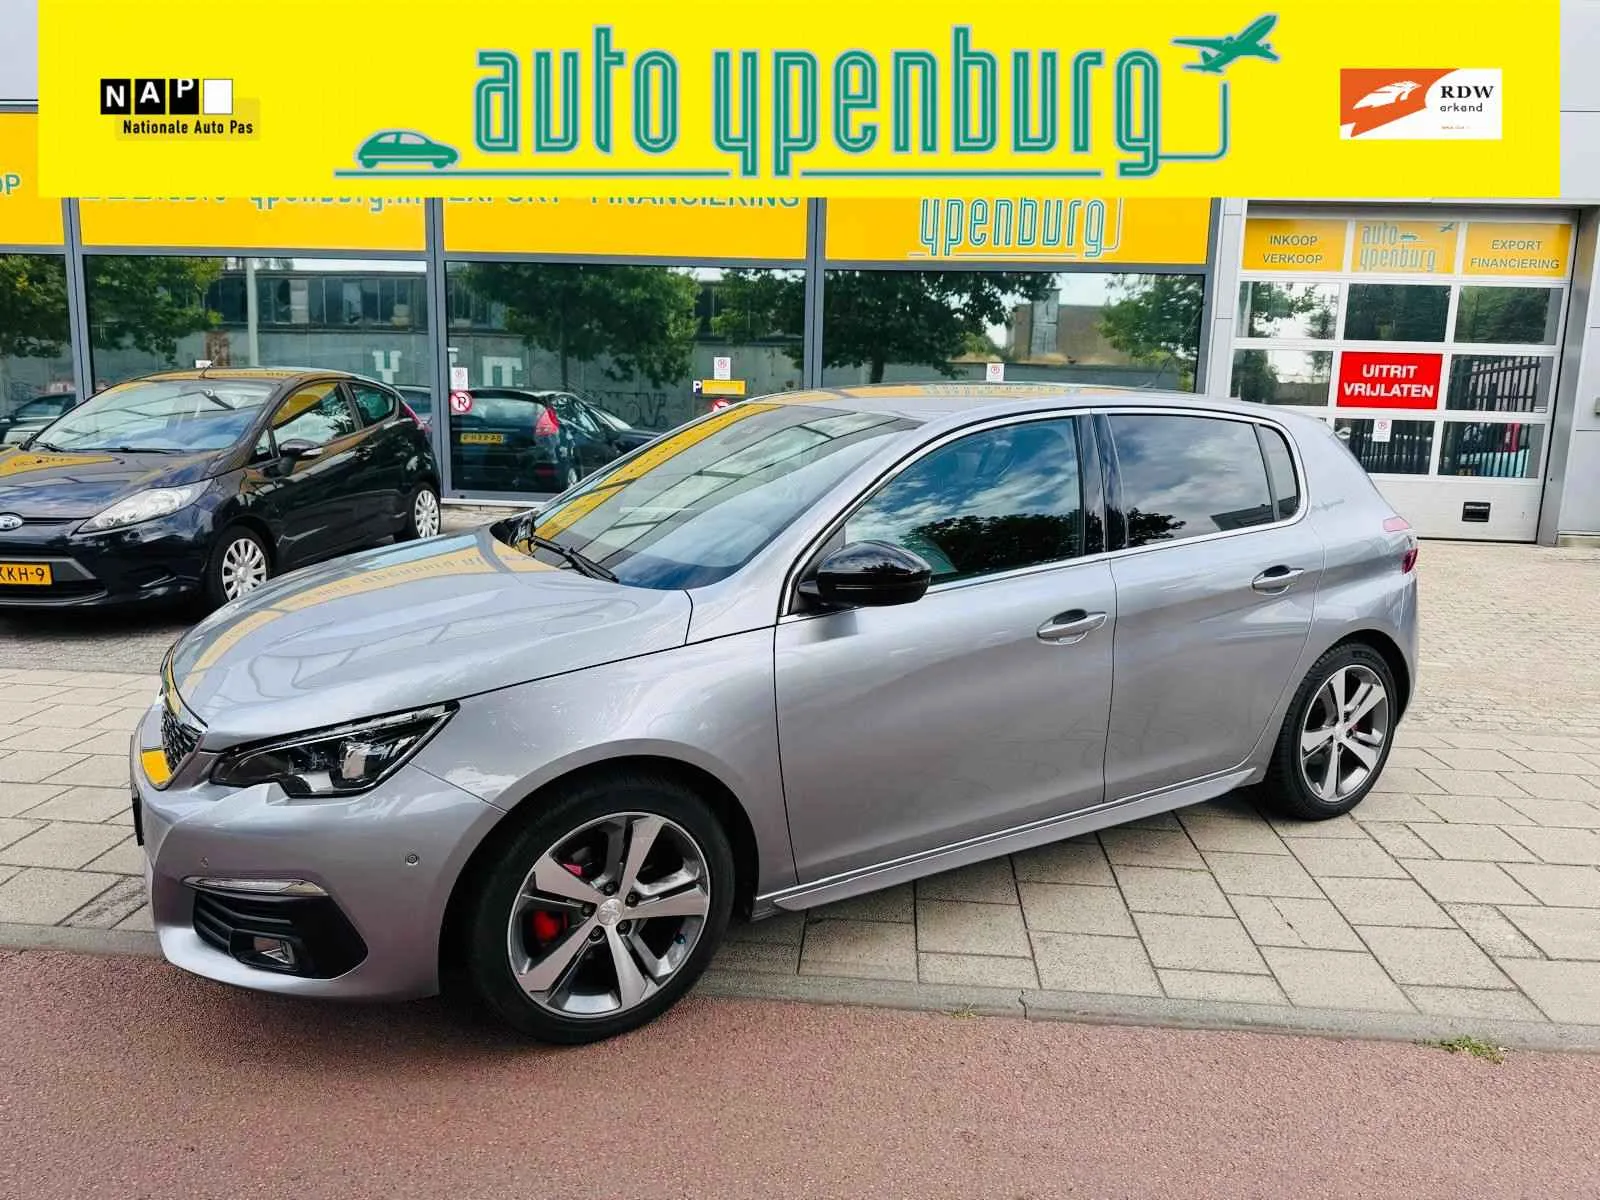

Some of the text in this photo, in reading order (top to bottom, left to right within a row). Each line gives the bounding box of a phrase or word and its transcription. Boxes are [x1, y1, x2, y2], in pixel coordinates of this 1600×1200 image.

[1269, 235, 1318, 247] INKOOP
[1491, 239, 1543, 251] EXPORT
[1263, 252, 1323, 265] VERKOOP
[1470, 257, 1560, 269] FINANCIERING
[1361, 363, 1418, 379] UITRIT
[1343, 382, 1435, 398] VRIJLATEN
